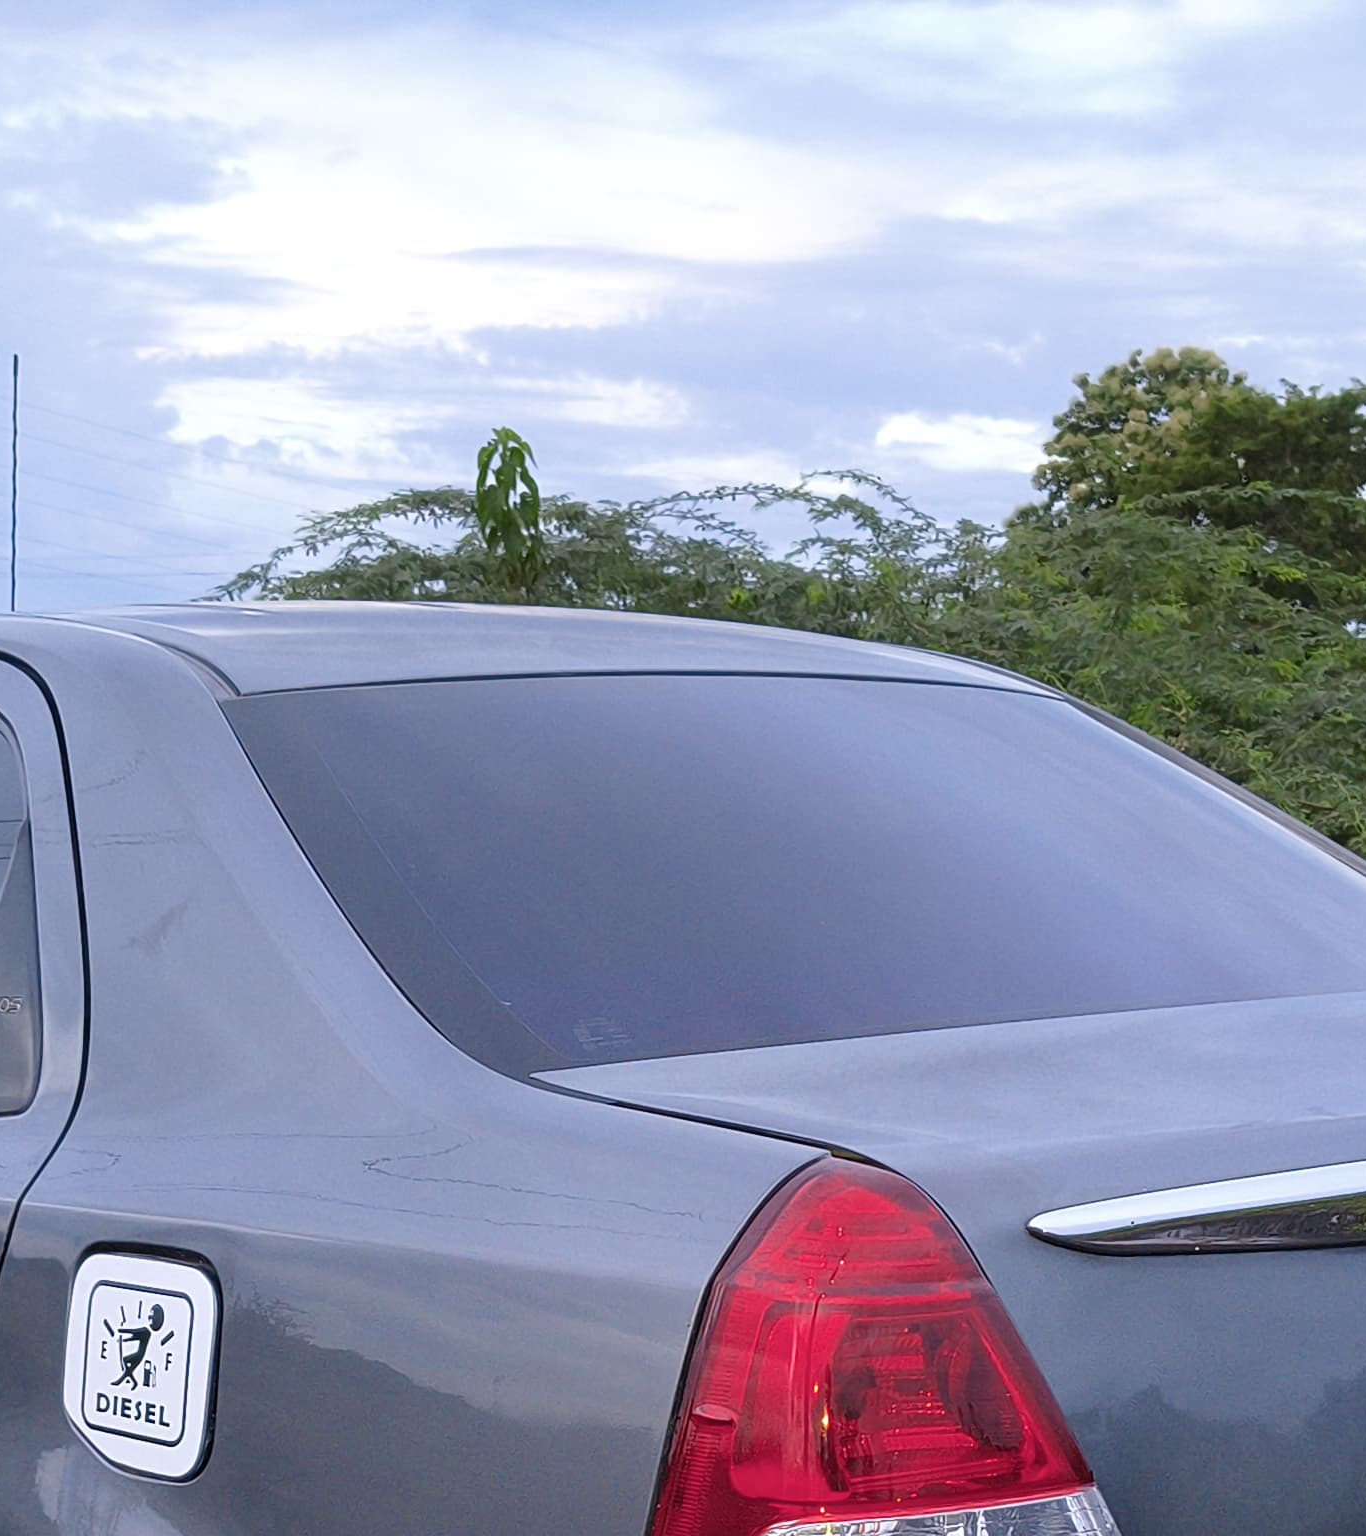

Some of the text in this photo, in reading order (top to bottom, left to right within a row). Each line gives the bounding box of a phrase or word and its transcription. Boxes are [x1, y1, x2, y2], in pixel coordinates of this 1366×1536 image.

[100, 1340, 108, 1360] E
[164, 1352, 173, 1372] F
[95, 1391, 171, 1428] DIESEL
